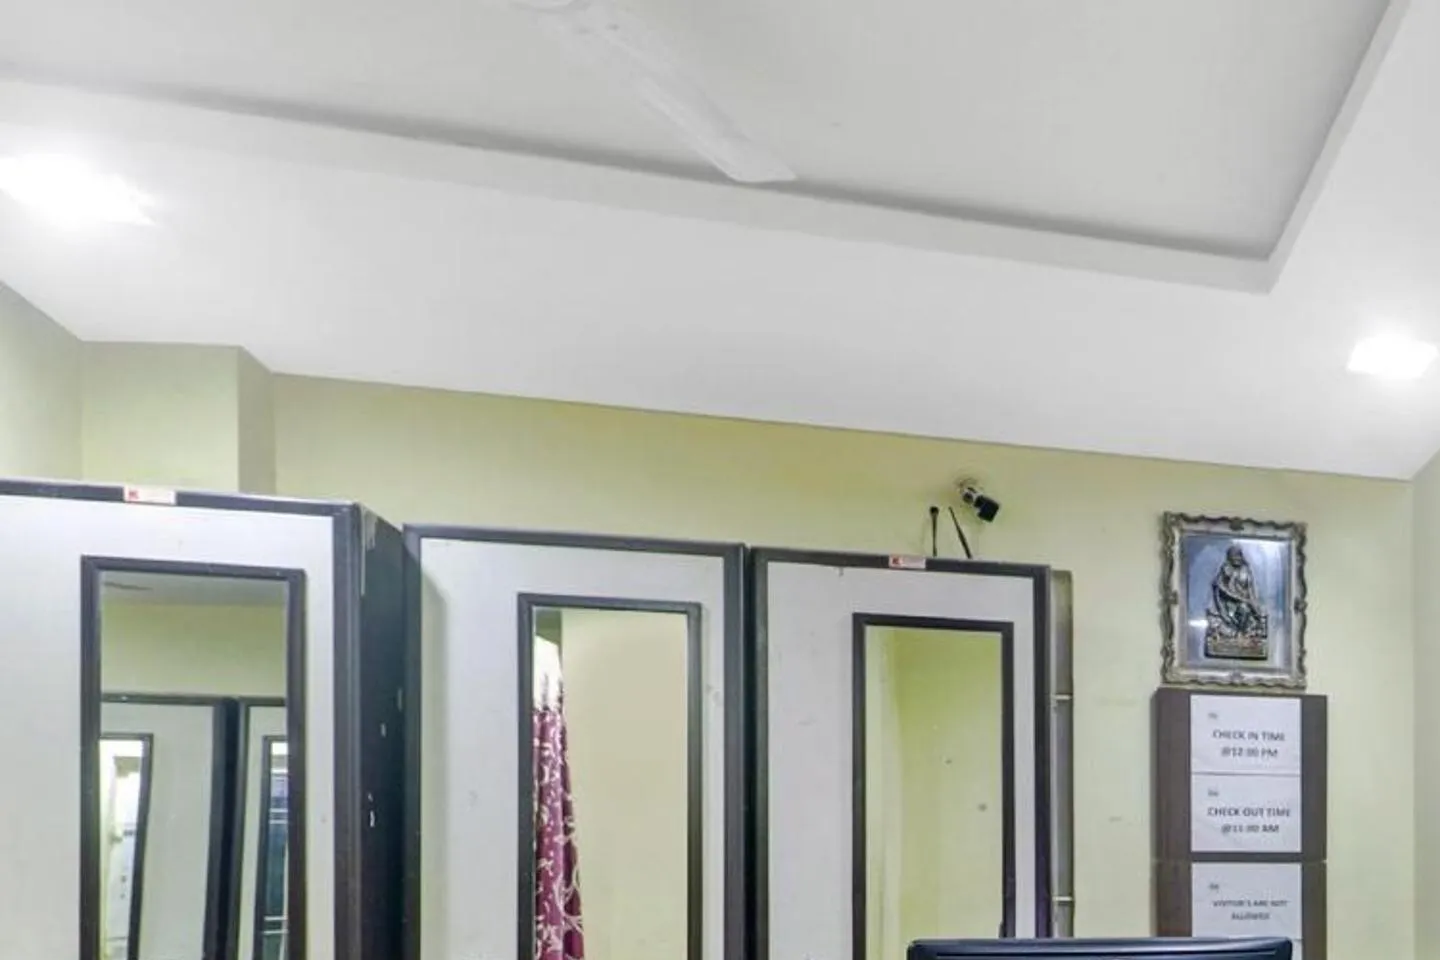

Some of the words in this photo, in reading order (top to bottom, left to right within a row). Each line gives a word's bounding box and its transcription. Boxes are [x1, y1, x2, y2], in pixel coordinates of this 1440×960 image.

[1212, 730, 1246, 740] CHECK
[1247, 731, 1259, 741] IN
[1261, 731, 1285, 741] TIME
[1261, 747, 1279, 758] PM
[1207, 807, 1241, 817] CHECK
[1243, 807, 1264, 818] OUT
[1265, 807, 1290, 817] TIME
[1261, 824, 1280, 834] AM
